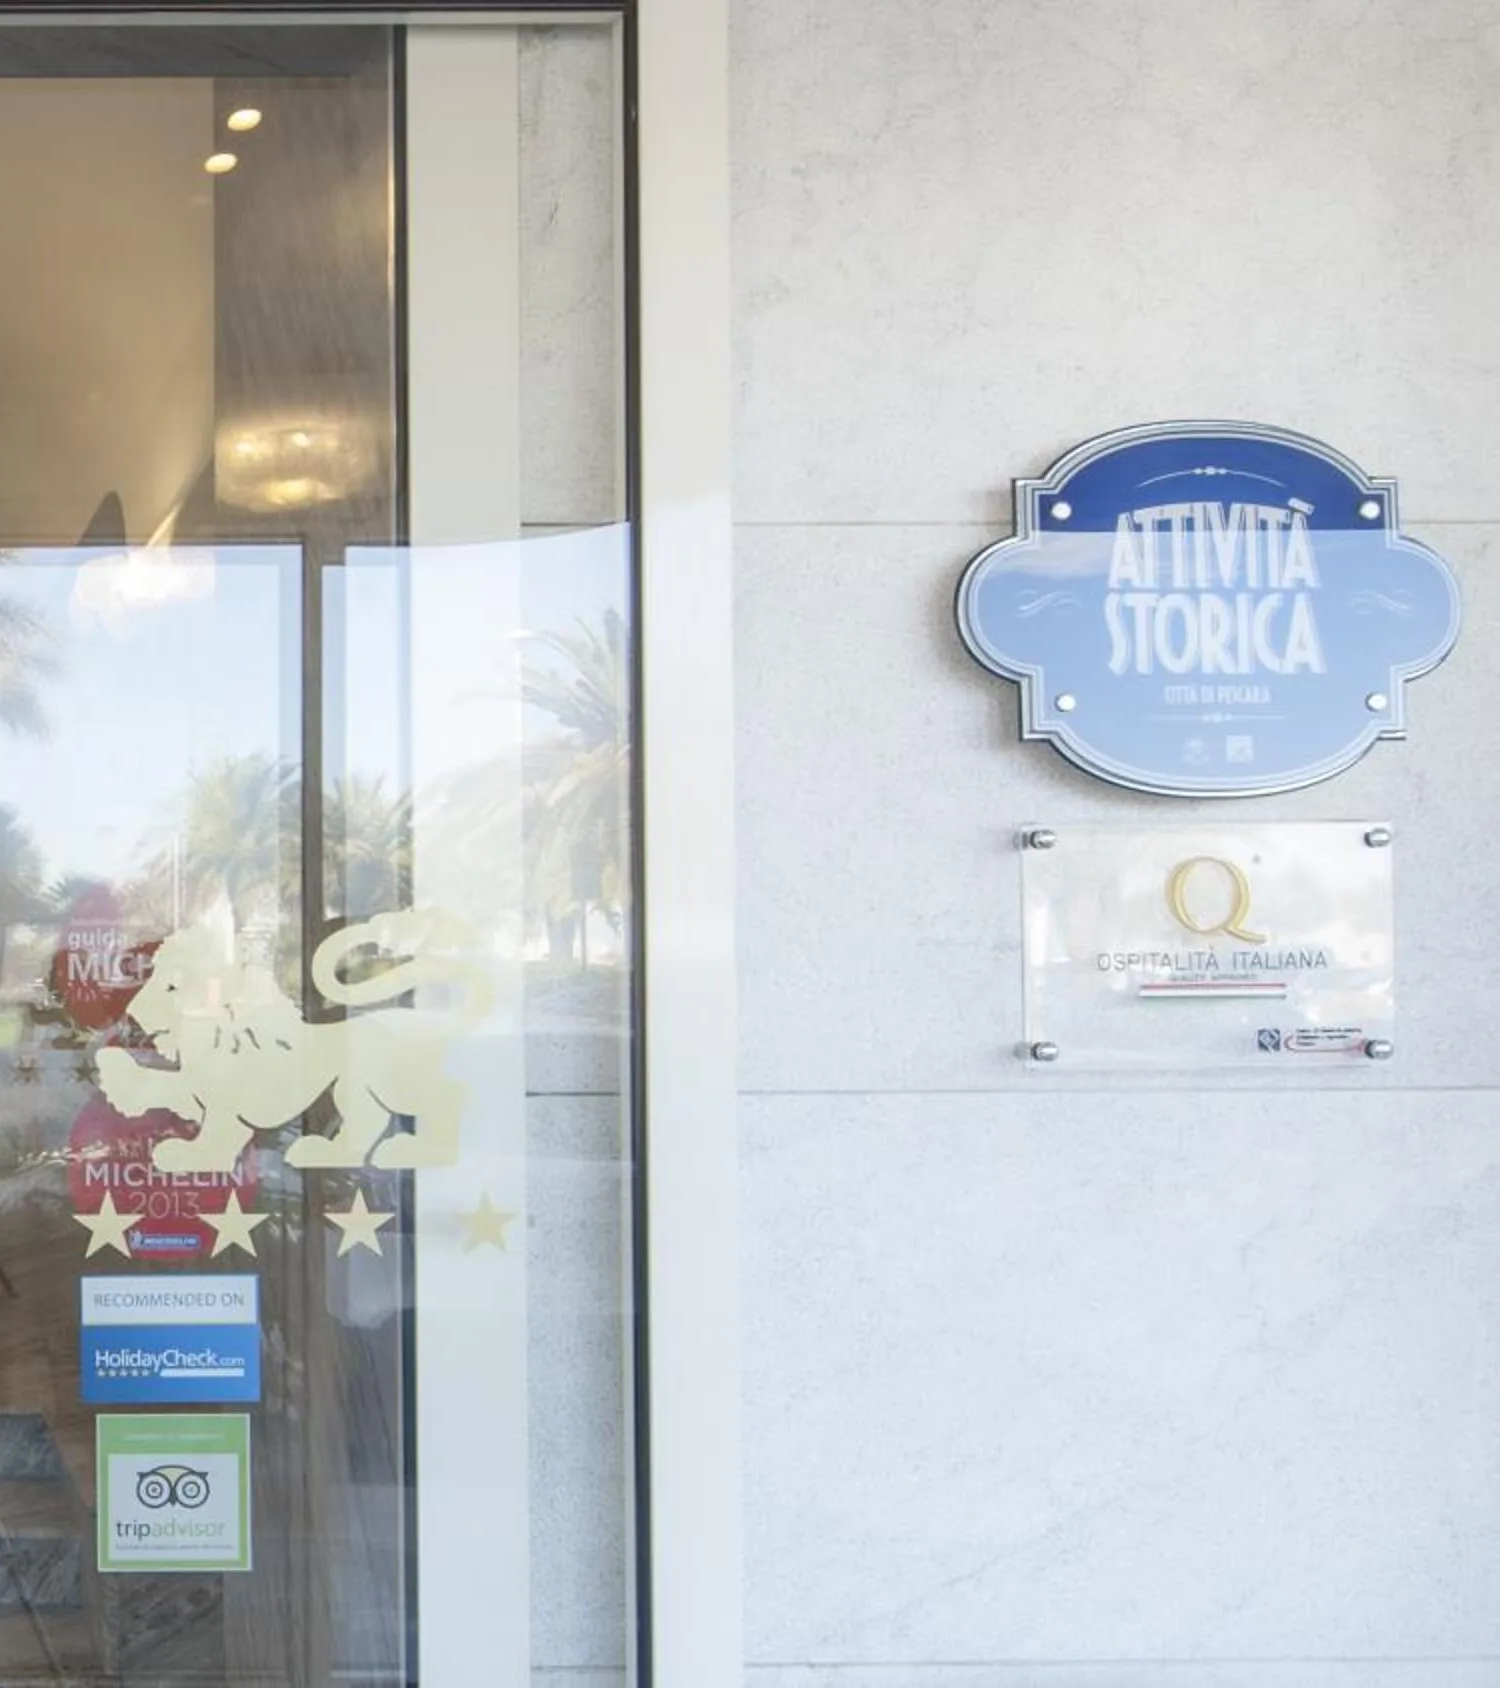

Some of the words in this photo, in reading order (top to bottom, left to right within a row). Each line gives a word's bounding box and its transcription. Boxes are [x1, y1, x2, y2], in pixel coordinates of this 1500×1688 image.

[1108, 498, 1320, 589] ATTIVITÀ
[1104, 592, 1327, 676] STORICA
[1164, 856, 1267, 945] Q
[66, 951, 155, 983] MICH
[1097, 945, 1220, 972] OSPITALITÀ
[1232, 950, 1329, 970] ITALIANA
[127, 1190, 201, 1220] 2013
[94, 1291, 217, 1309] RECOMMENDED
[221, 1290, 245, 1308] ON
[116, 1516, 227, 1542] tripadvisor
